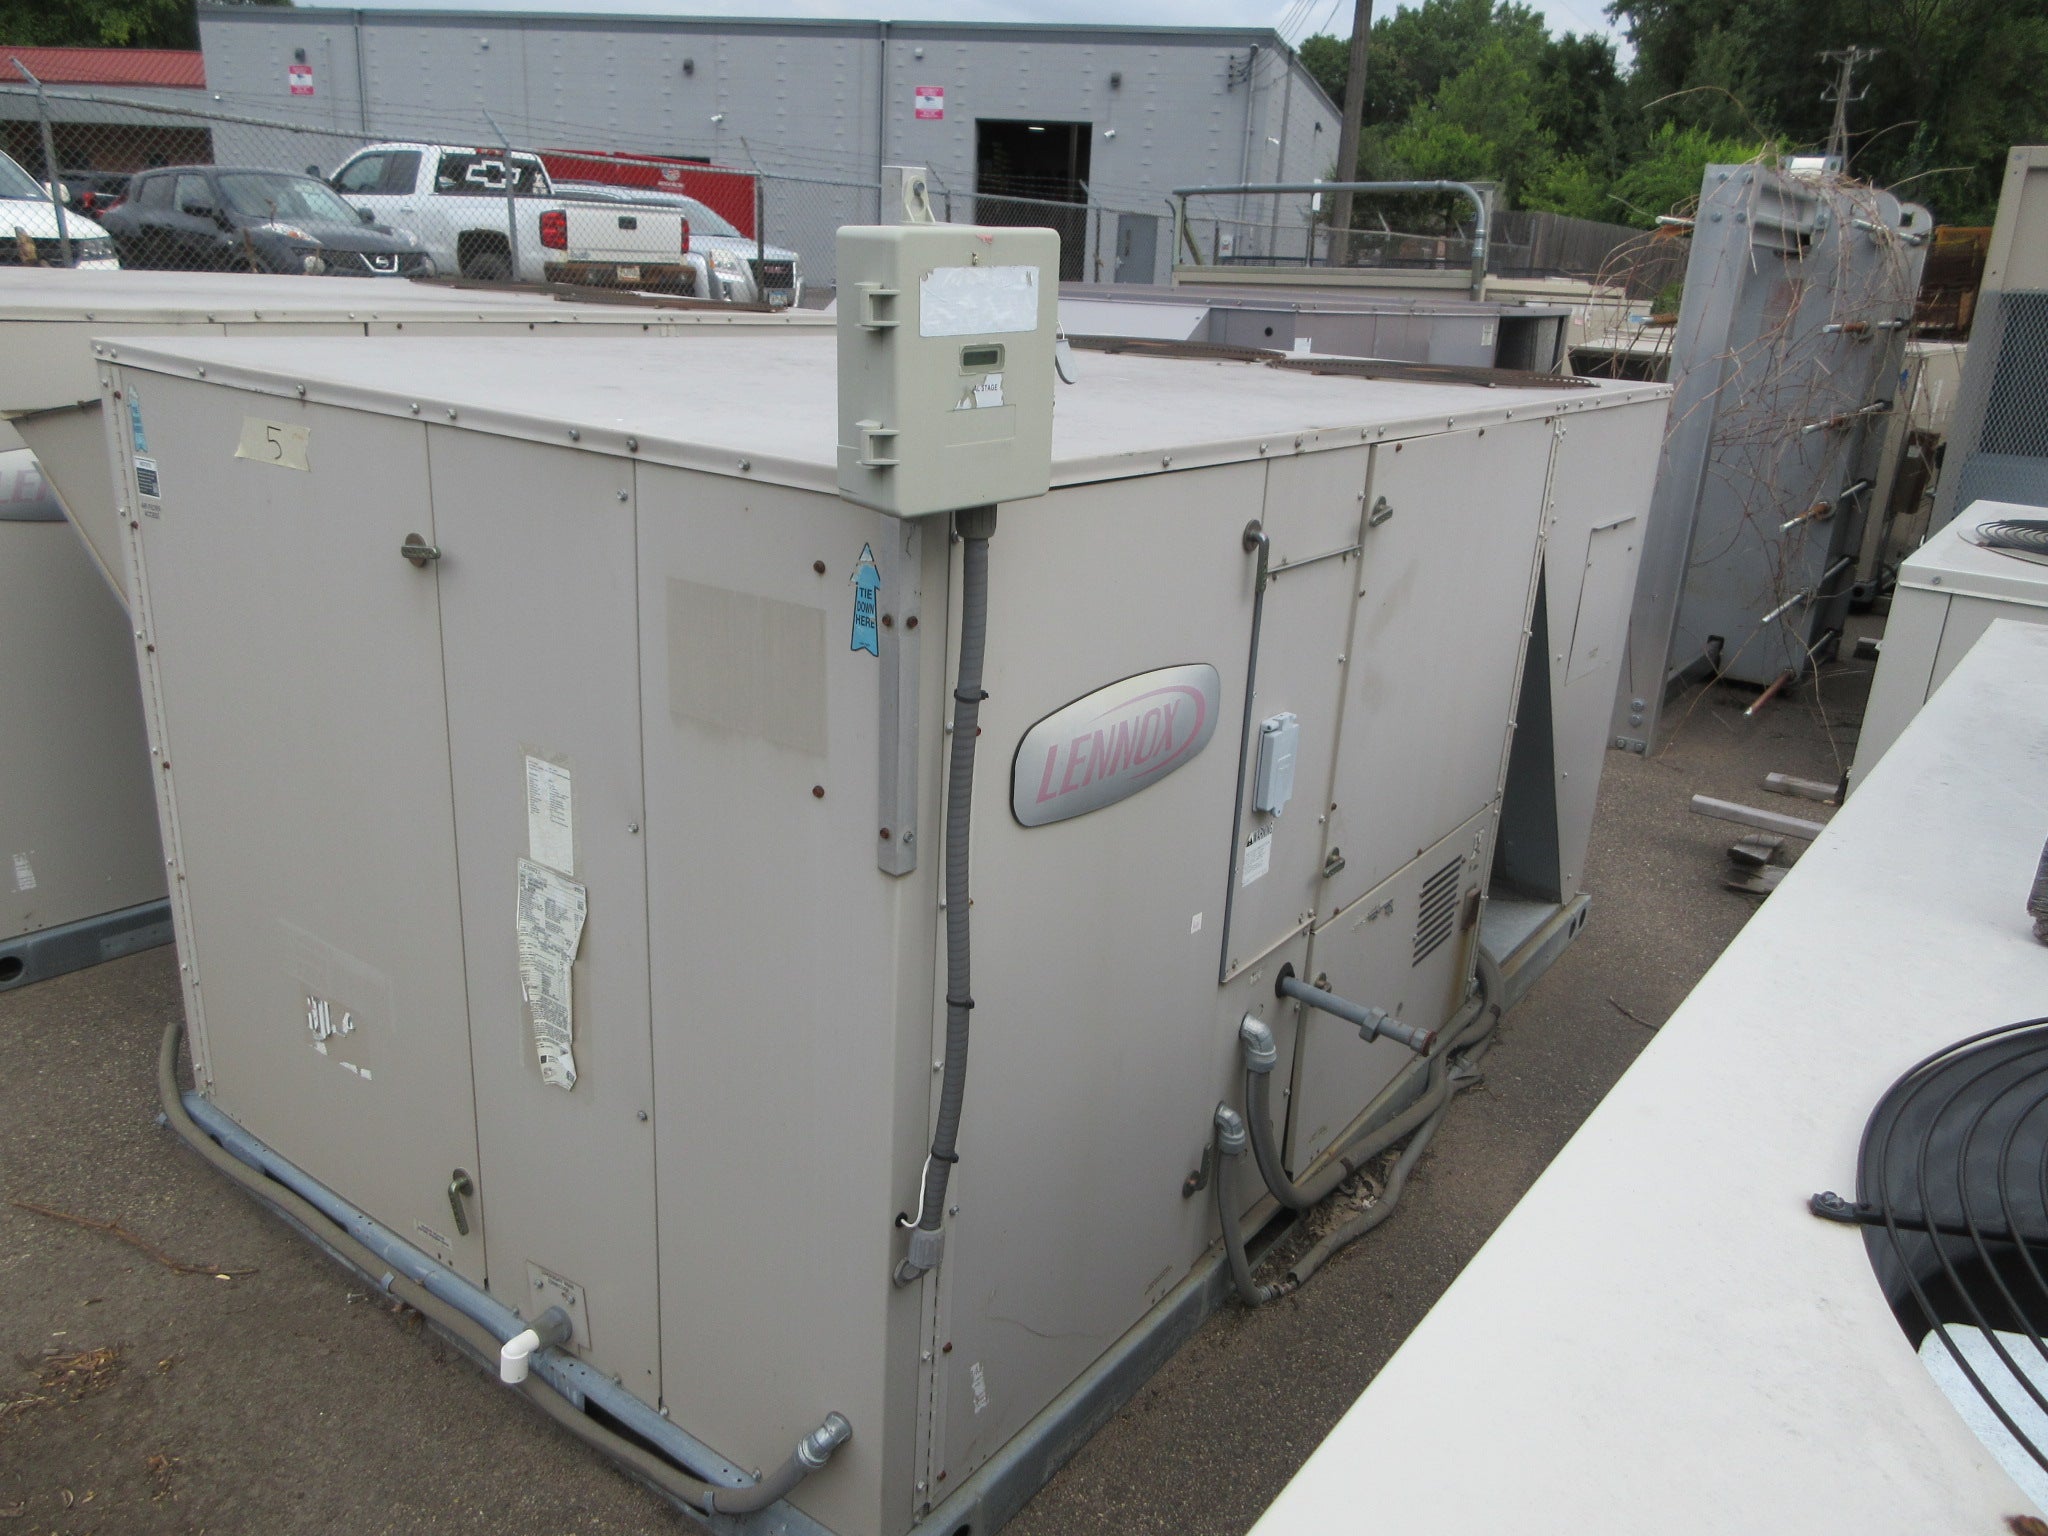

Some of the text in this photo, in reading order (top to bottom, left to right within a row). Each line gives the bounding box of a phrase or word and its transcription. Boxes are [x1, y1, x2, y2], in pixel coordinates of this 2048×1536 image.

[981, 383, 998, 392] STAGE
[267, 425, 283, 460] 5
[859, 587, 873, 600] TIE
[856, 600, 875, 615] DOWN
[855, 613, 876, 629] HERE
[1036, 698, 1182, 804] LENNOX
